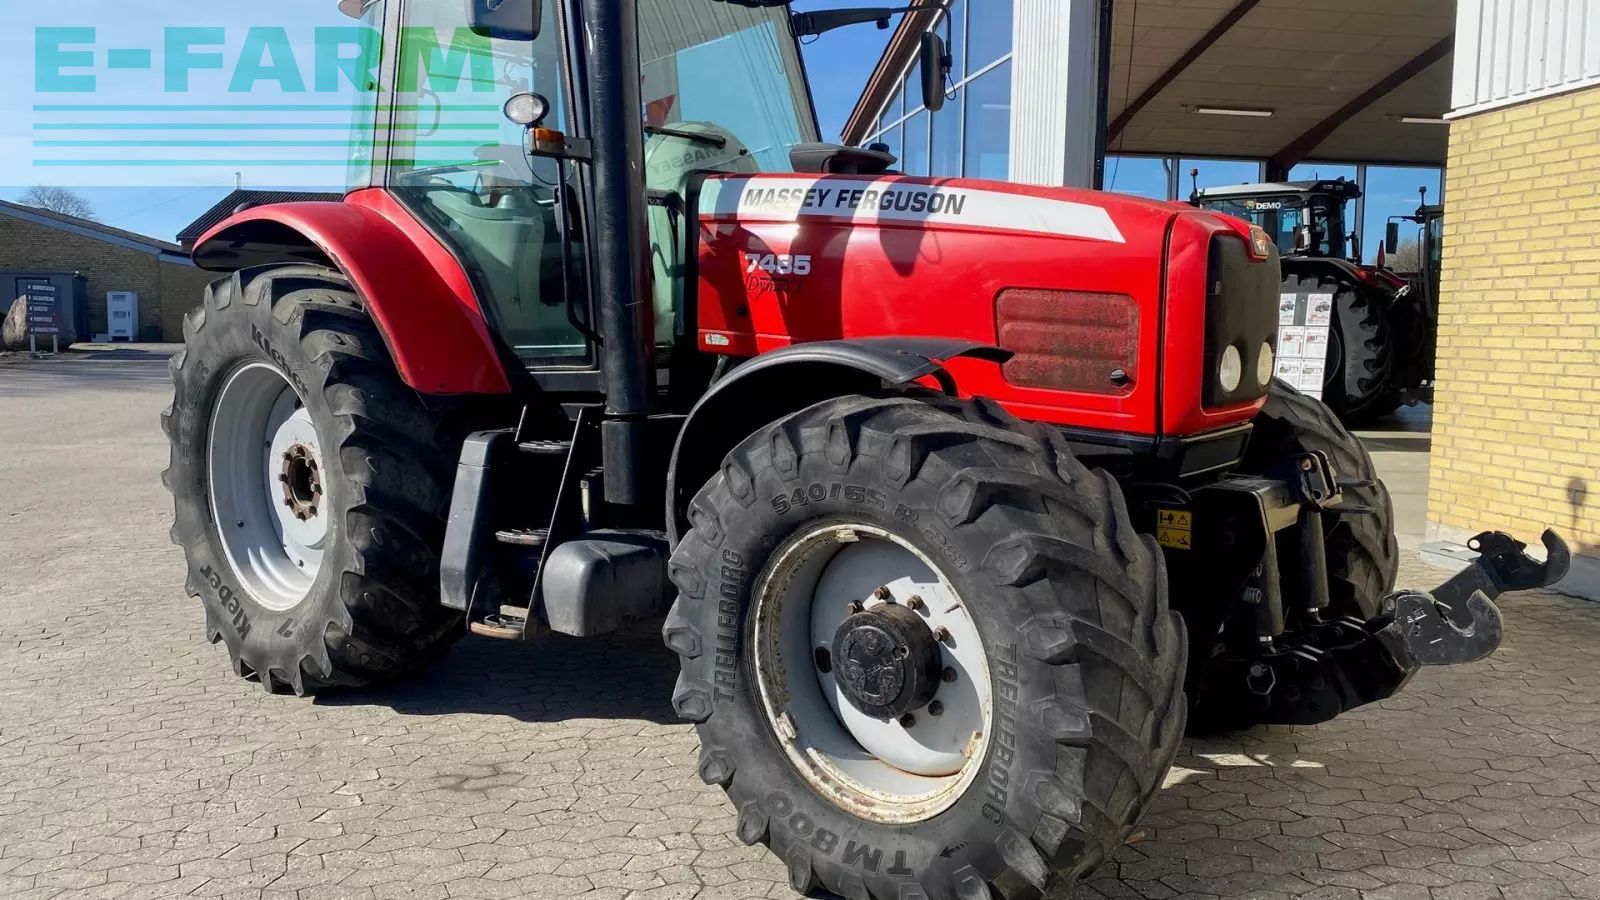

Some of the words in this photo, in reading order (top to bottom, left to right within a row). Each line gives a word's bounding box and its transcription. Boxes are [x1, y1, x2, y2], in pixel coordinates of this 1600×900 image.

[744, 187, 832, 208] MASSEY
[834, 188, 967, 215] FERGUSON
[1255, 201, 1282, 210] DEMO
[250, 322, 310, 398] Kleber
[200, 564, 252, 641] Kleber
[713, 548, 745, 704] TRELLEBORG
[981, 642, 1020, 827] TRELLEBORG
